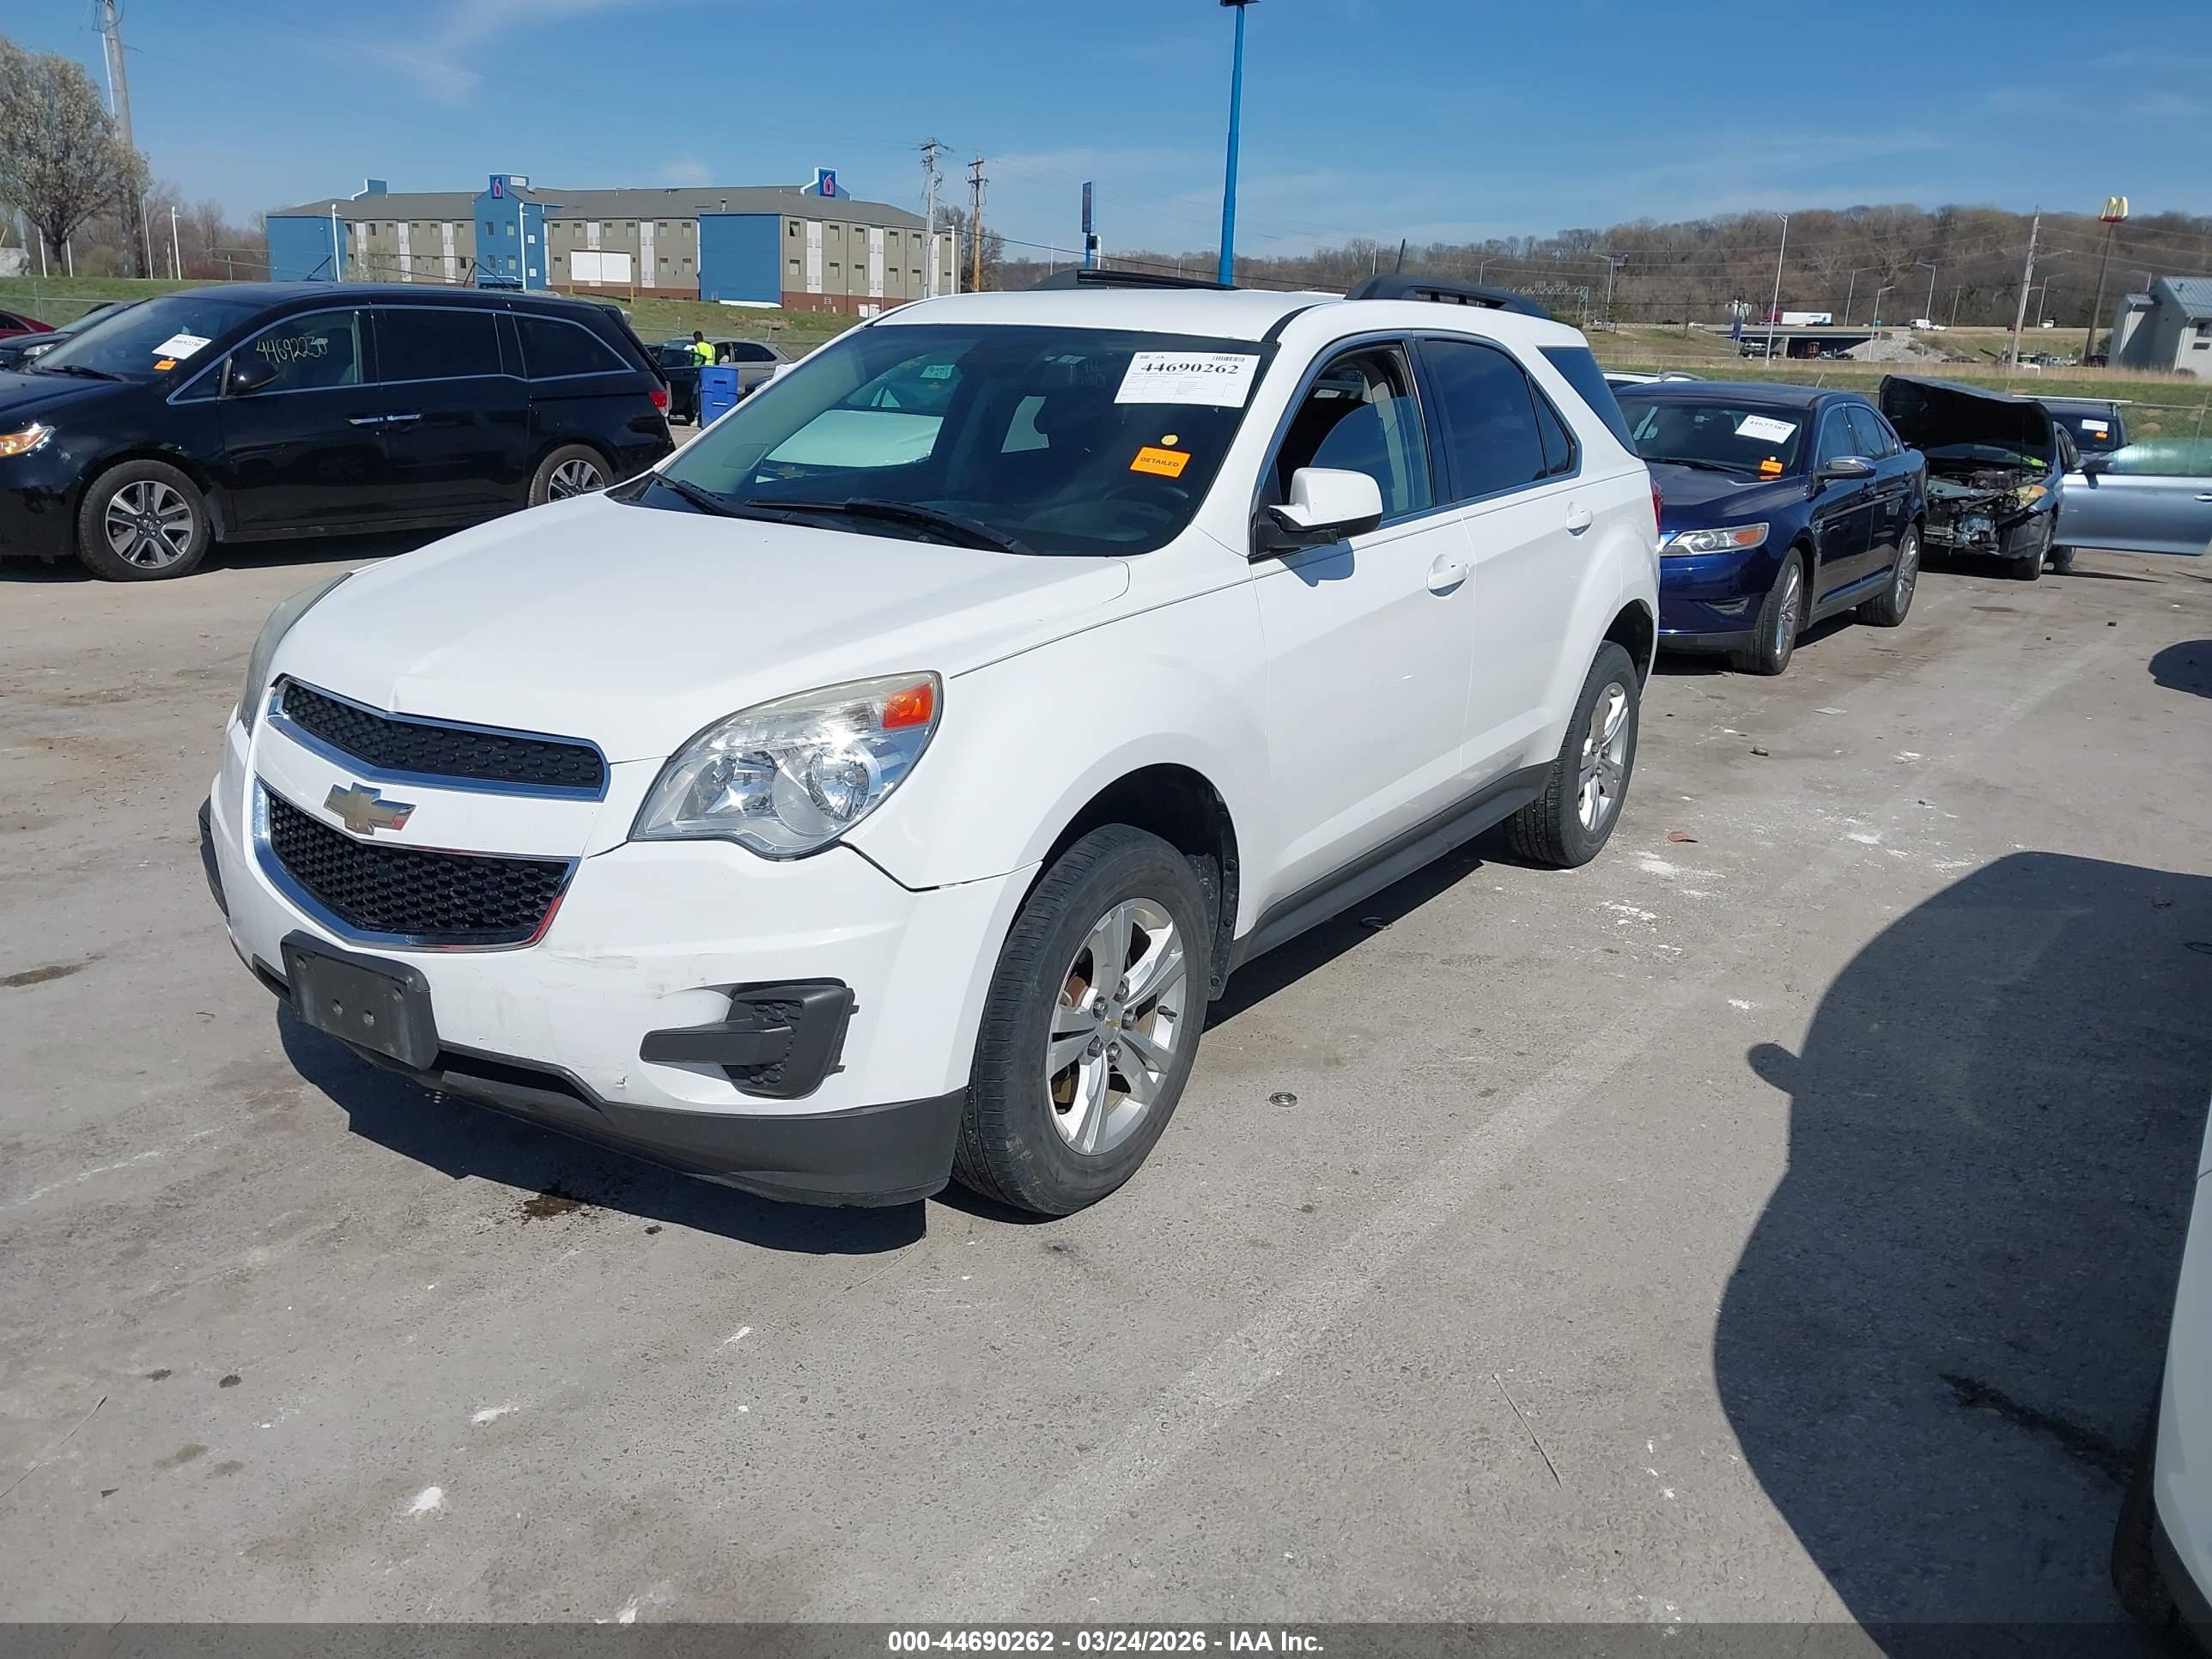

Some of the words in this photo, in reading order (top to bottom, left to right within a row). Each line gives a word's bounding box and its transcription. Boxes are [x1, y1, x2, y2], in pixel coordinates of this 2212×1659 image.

[494, 178, 502, 198] 6
[823, 173, 834, 195] 6
[1141, 362, 1239, 374] 44690262
[1140, 456, 1179, 467] DETAILED
